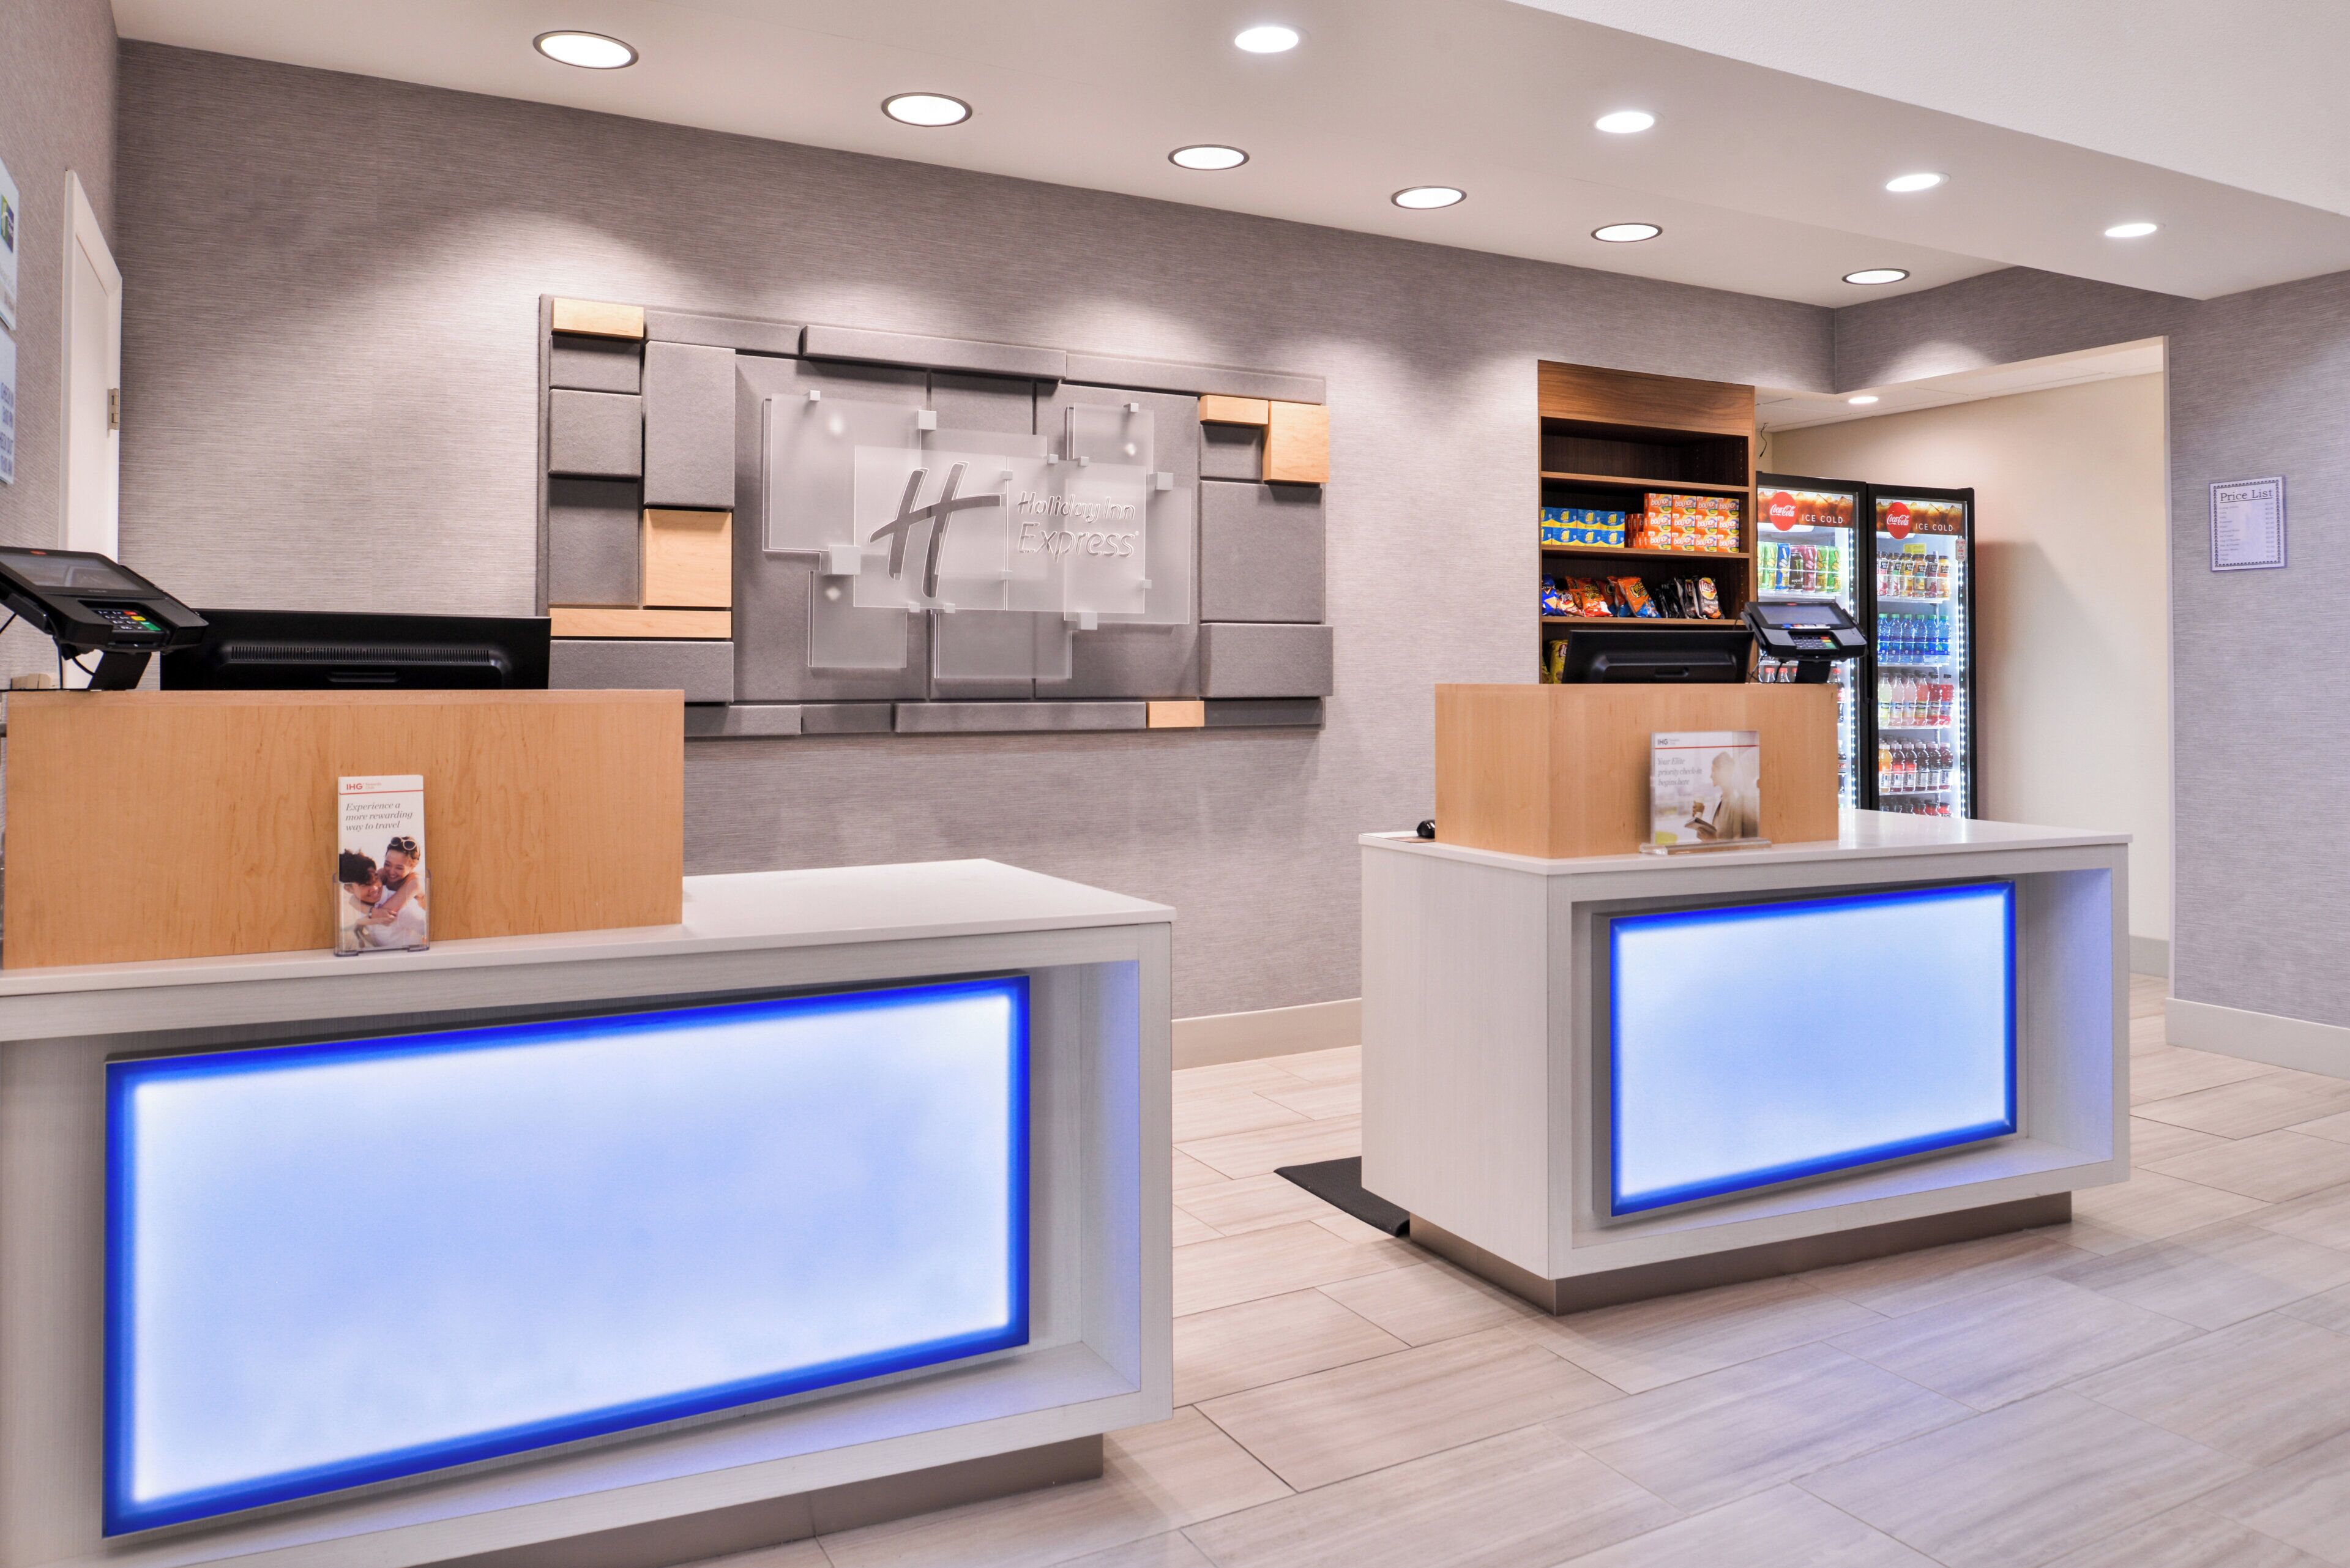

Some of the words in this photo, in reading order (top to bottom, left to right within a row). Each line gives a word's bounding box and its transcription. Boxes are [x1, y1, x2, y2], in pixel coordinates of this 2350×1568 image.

[2220, 492, 2247, 501] Price
[2252, 489, 2273, 498] List
[1018, 491, 1100, 523] Holiday
[1103, 496, 1135, 520] Inn
[1608, 513, 1617, 523] all
[1561, 530, 1570, 540] all
[1609, 532, 1617, 542] all
[1018, 521, 1135, 563] Express
[1658, 768, 1678, 777] priority
[1658, 778, 1677, 787] begins
[346, 802, 394, 812] Experience
[369, 811, 413, 819] rewarding
[375, 821, 401, 829] travel
